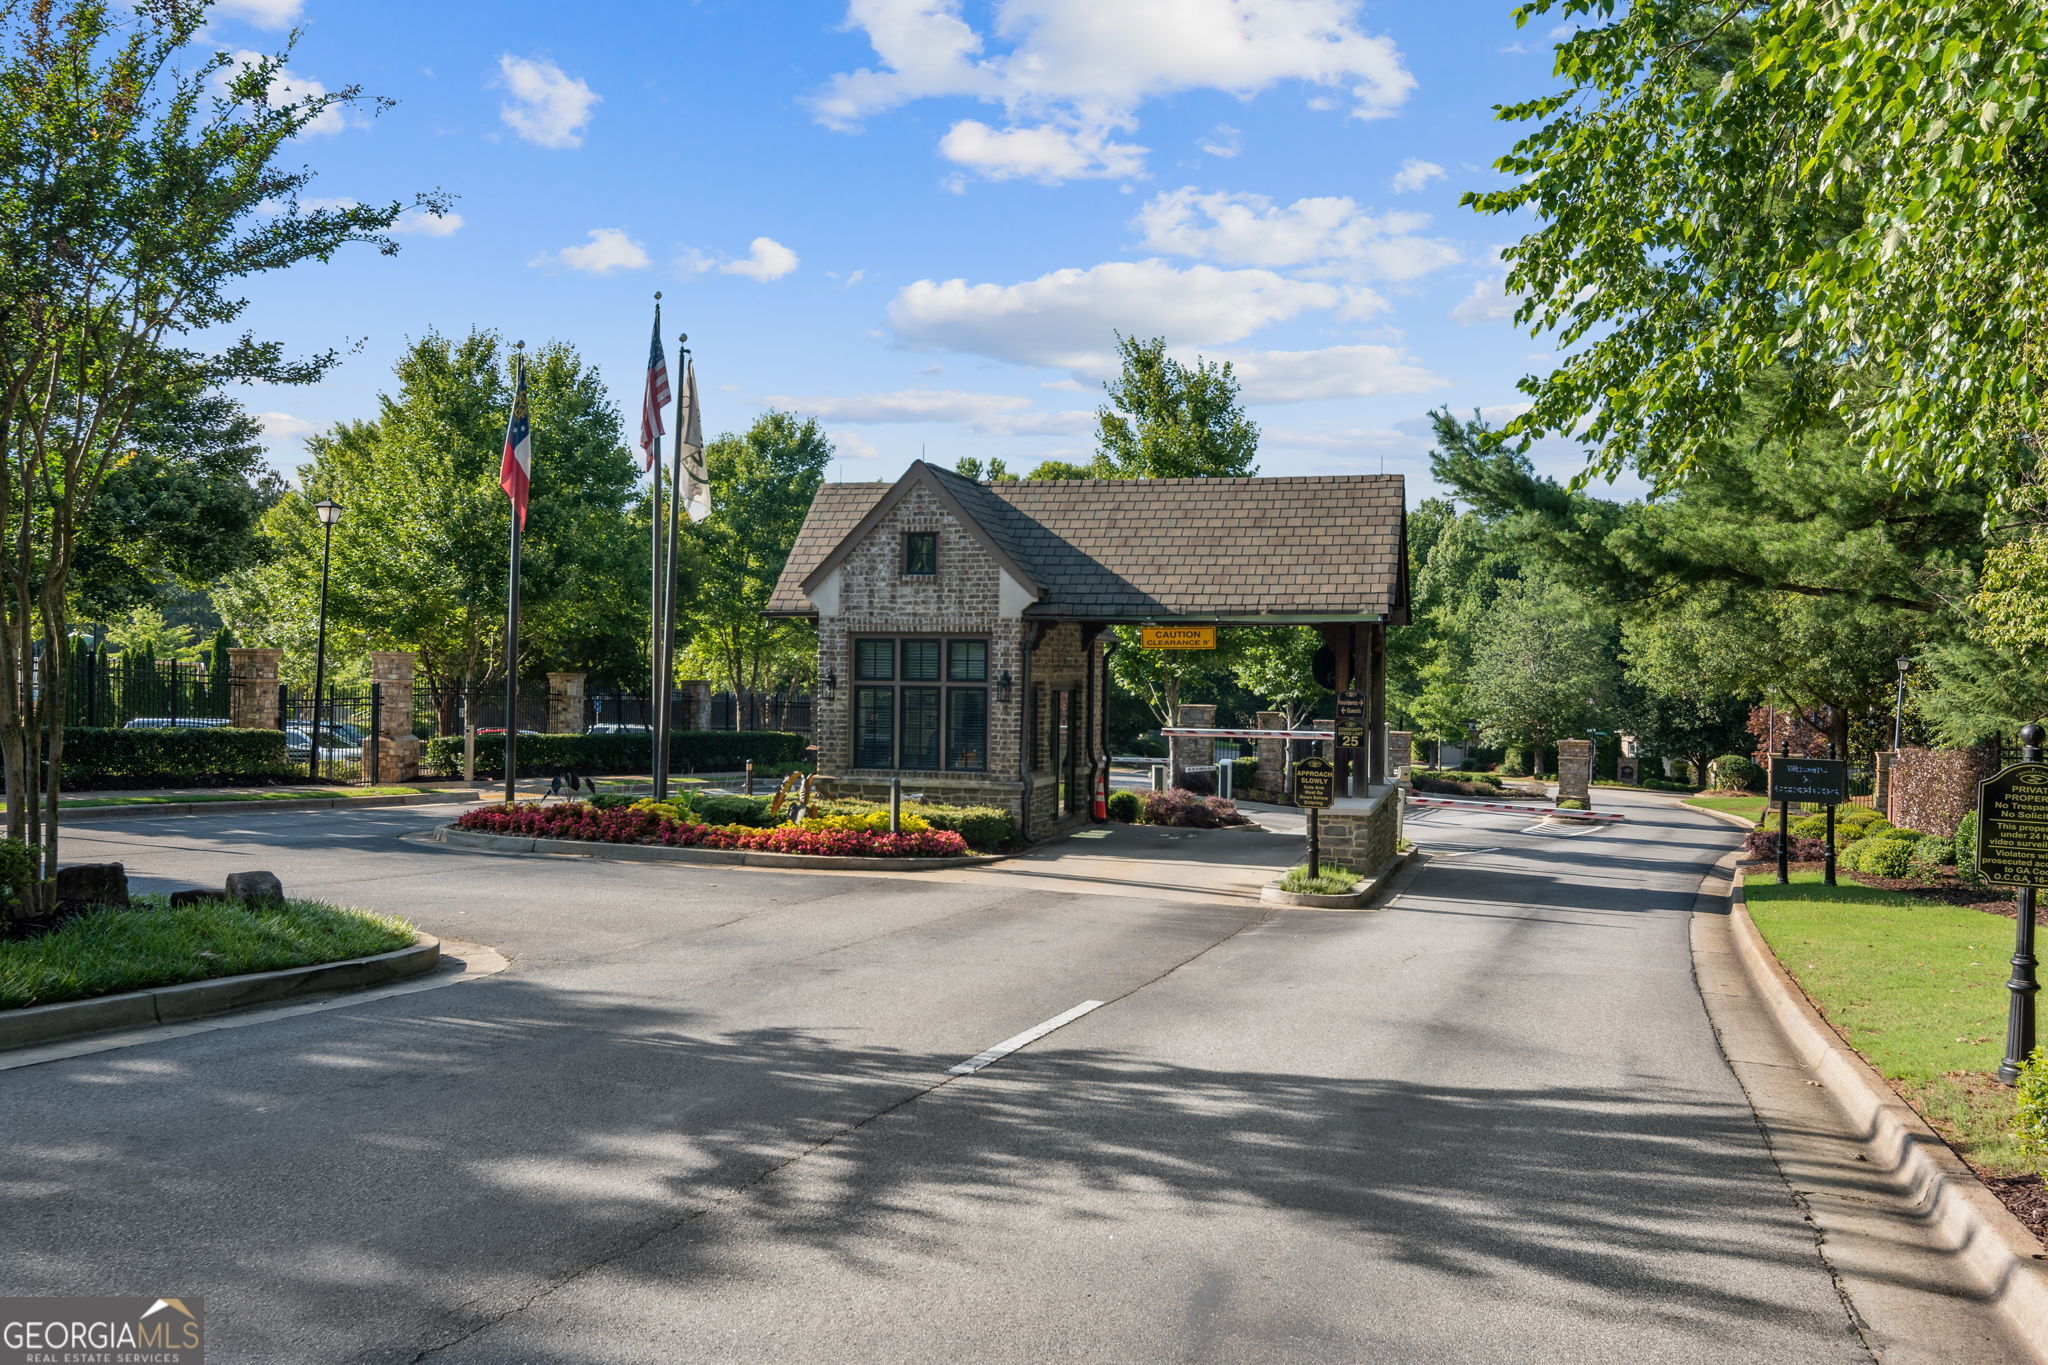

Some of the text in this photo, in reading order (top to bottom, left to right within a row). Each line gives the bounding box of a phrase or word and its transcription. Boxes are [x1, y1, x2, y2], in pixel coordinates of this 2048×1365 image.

[1155, 630, 1200, 638] CAUTION
[1342, 736, 1359, 747] 25
[1996, 849, 2035, 858] Violators
[1982, 858, 2032, 866] prosecuted
